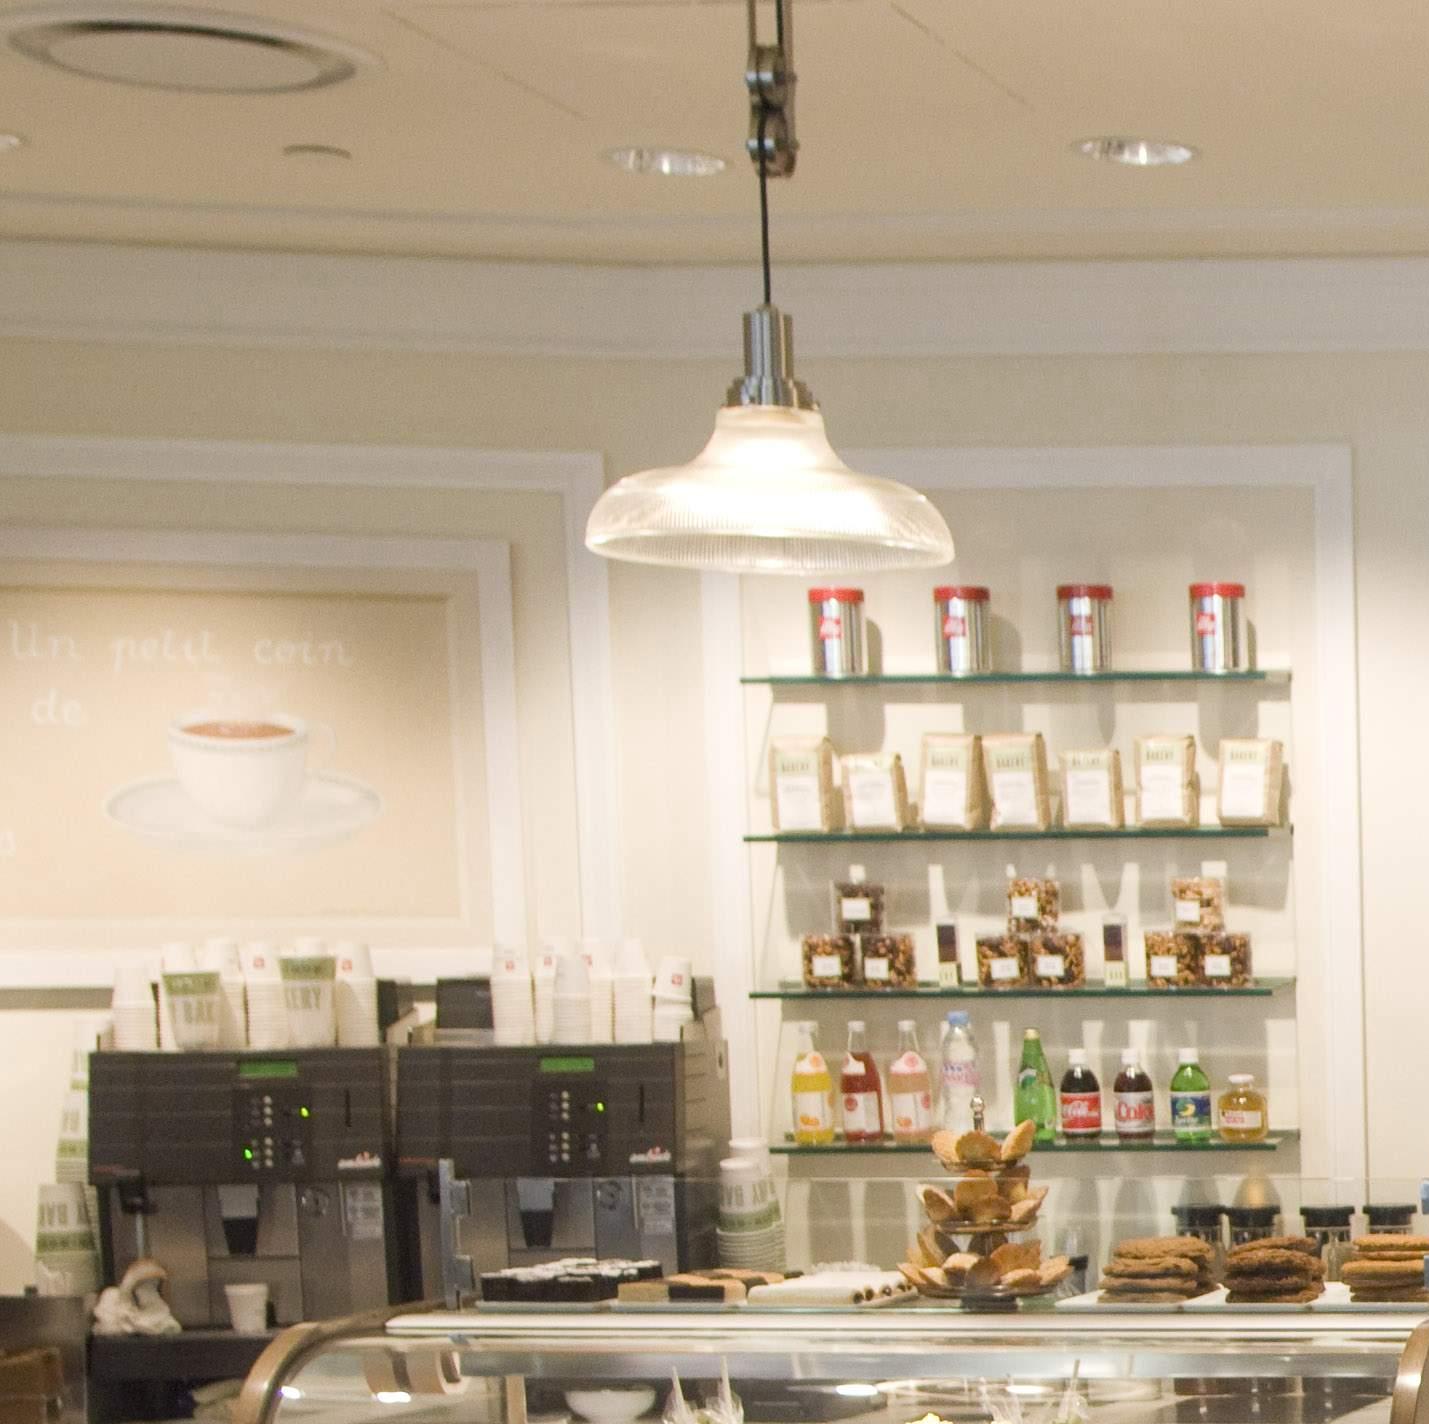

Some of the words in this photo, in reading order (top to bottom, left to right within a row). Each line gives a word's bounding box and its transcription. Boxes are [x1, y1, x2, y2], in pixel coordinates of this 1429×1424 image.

[9, 623, 80, 661] Un
[255, 637, 352, 667] coin
[31, 687, 82, 726] de
